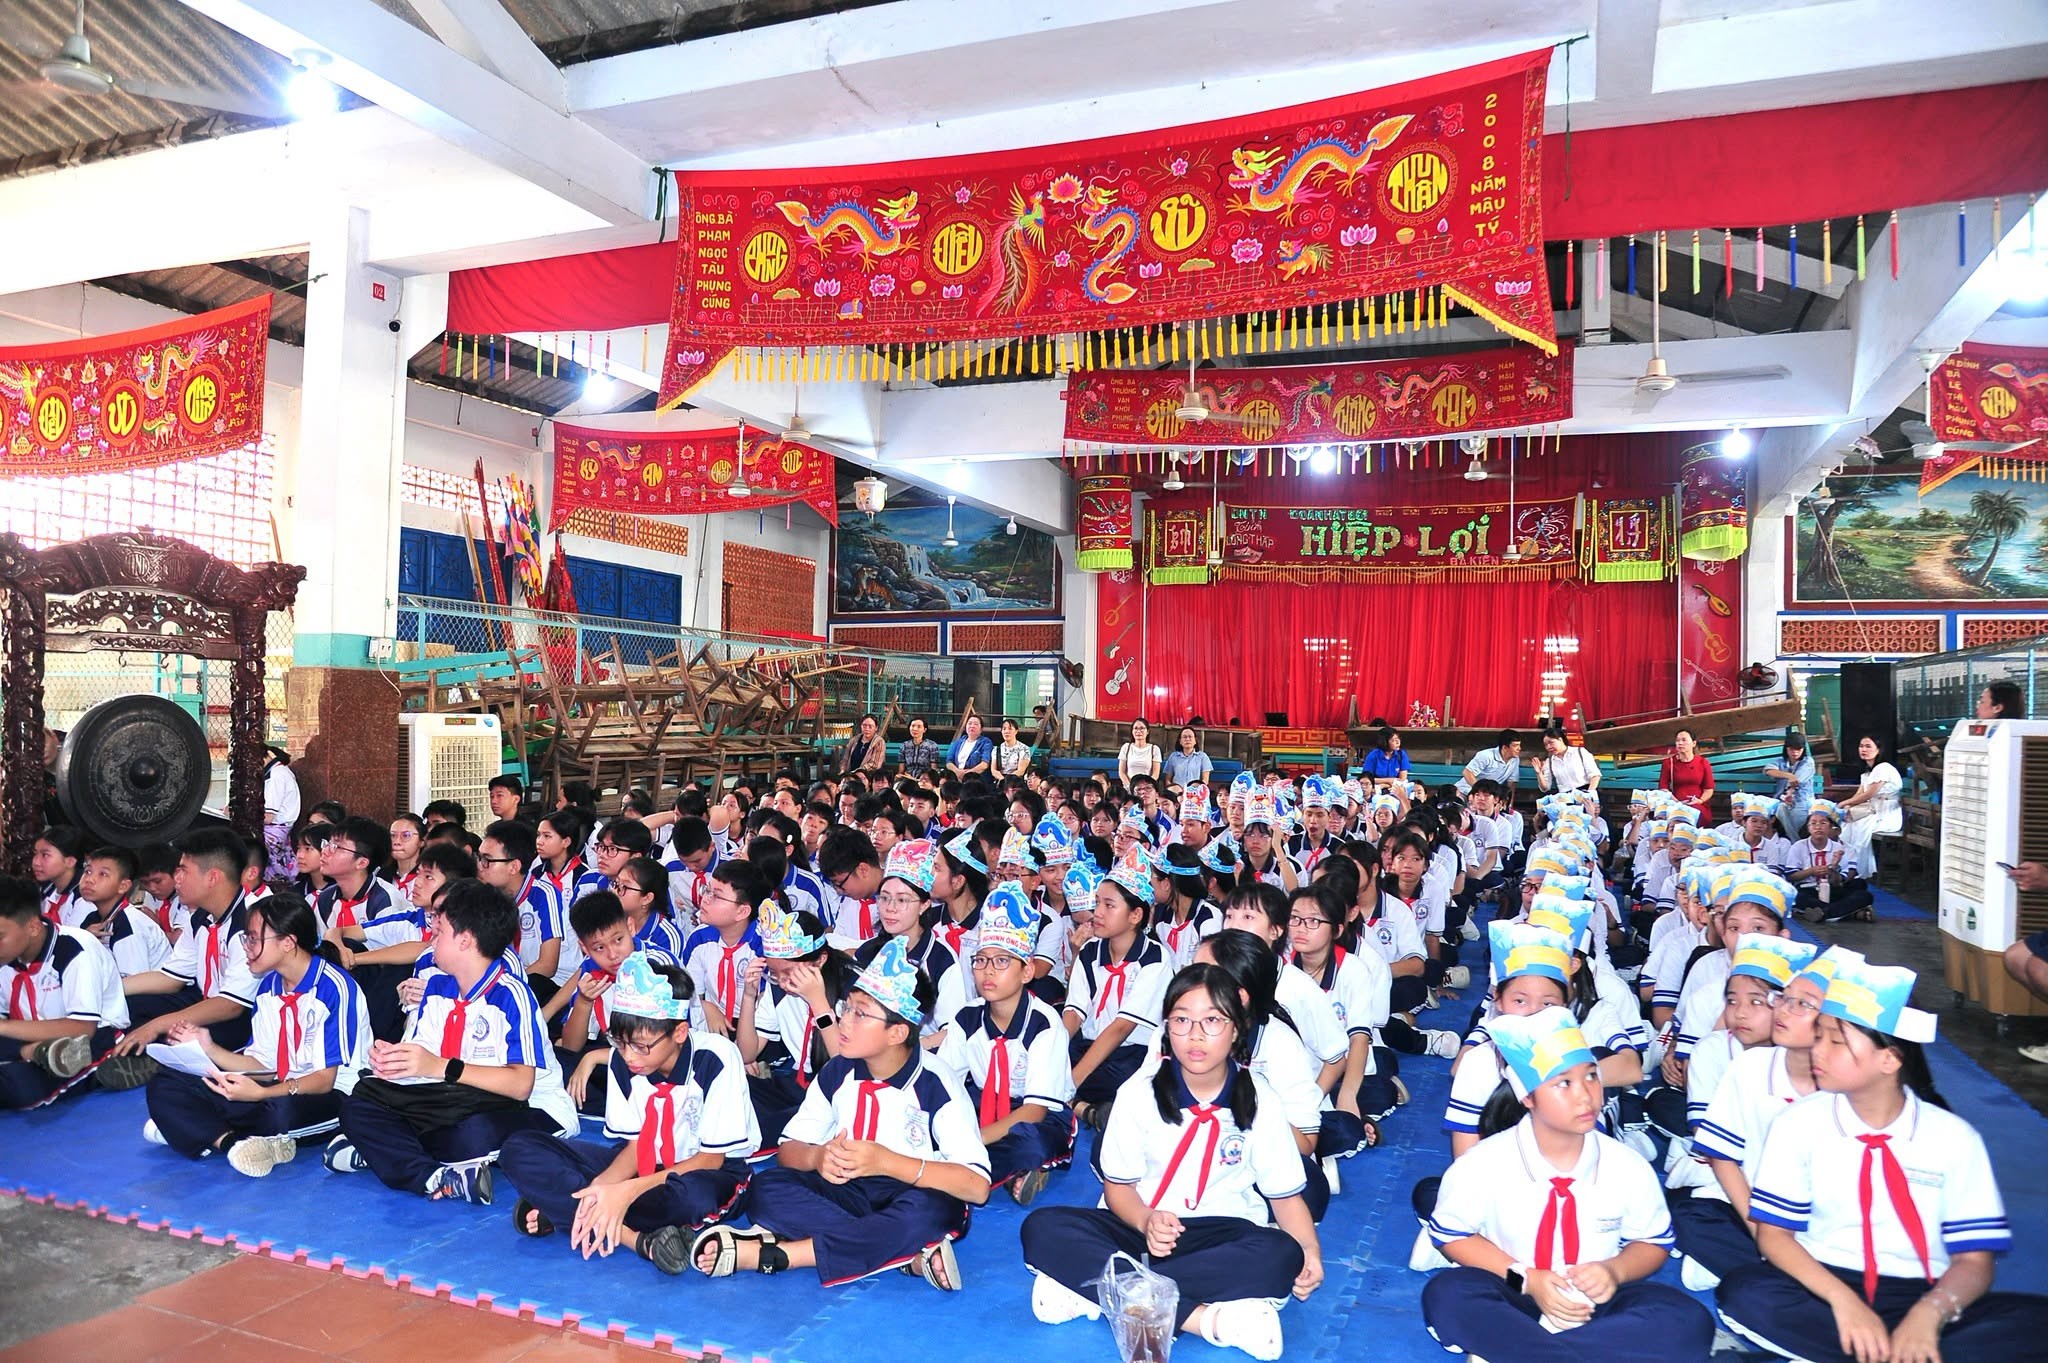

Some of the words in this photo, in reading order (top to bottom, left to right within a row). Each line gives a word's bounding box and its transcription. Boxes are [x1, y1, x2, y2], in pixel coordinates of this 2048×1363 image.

[1470, 176, 1506, 196] NĂM
[1469, 196, 1506, 217] MẬU
[718, 210, 734, 224] BÀ
[1475, 217, 1500, 236] TÝ
[698, 230, 731, 244] PHẠM
[698, 247, 728, 260] NGỌC
[702, 262, 724, 275] TÀU
[696, 280, 732, 294] PHỤNG
[702, 292, 730, 309] CÚNG
[1300, 520, 1402, 562] HIỆP
[1417, 514, 1490, 560] LỢI
